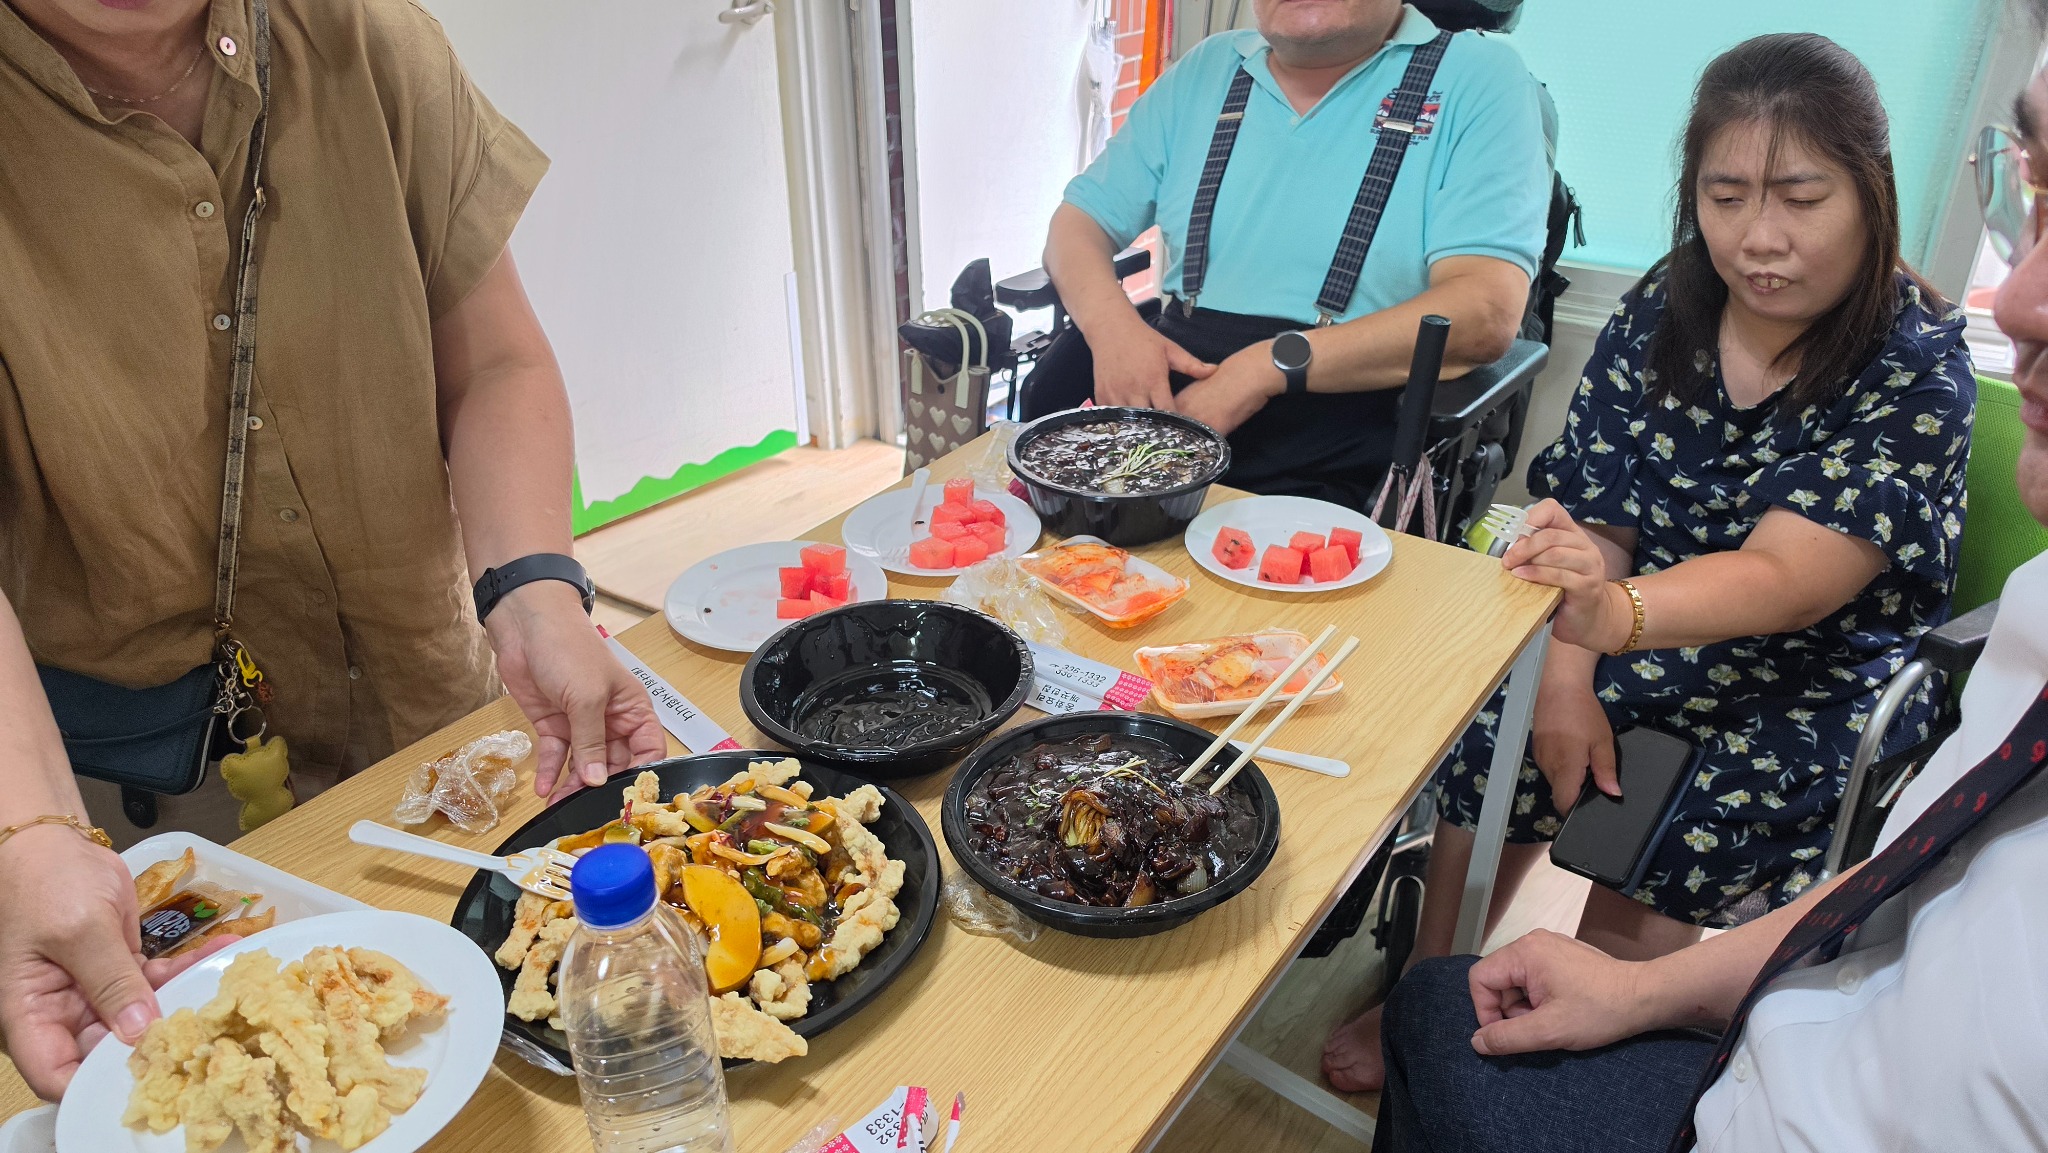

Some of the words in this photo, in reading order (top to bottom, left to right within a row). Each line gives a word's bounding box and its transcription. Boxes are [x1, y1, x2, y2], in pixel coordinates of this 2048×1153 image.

[651, 686, 696, 722] 감사합니다
[1036, 692, 1075, 712] 중화요리
[876, 1118, 902, 1145] 332
